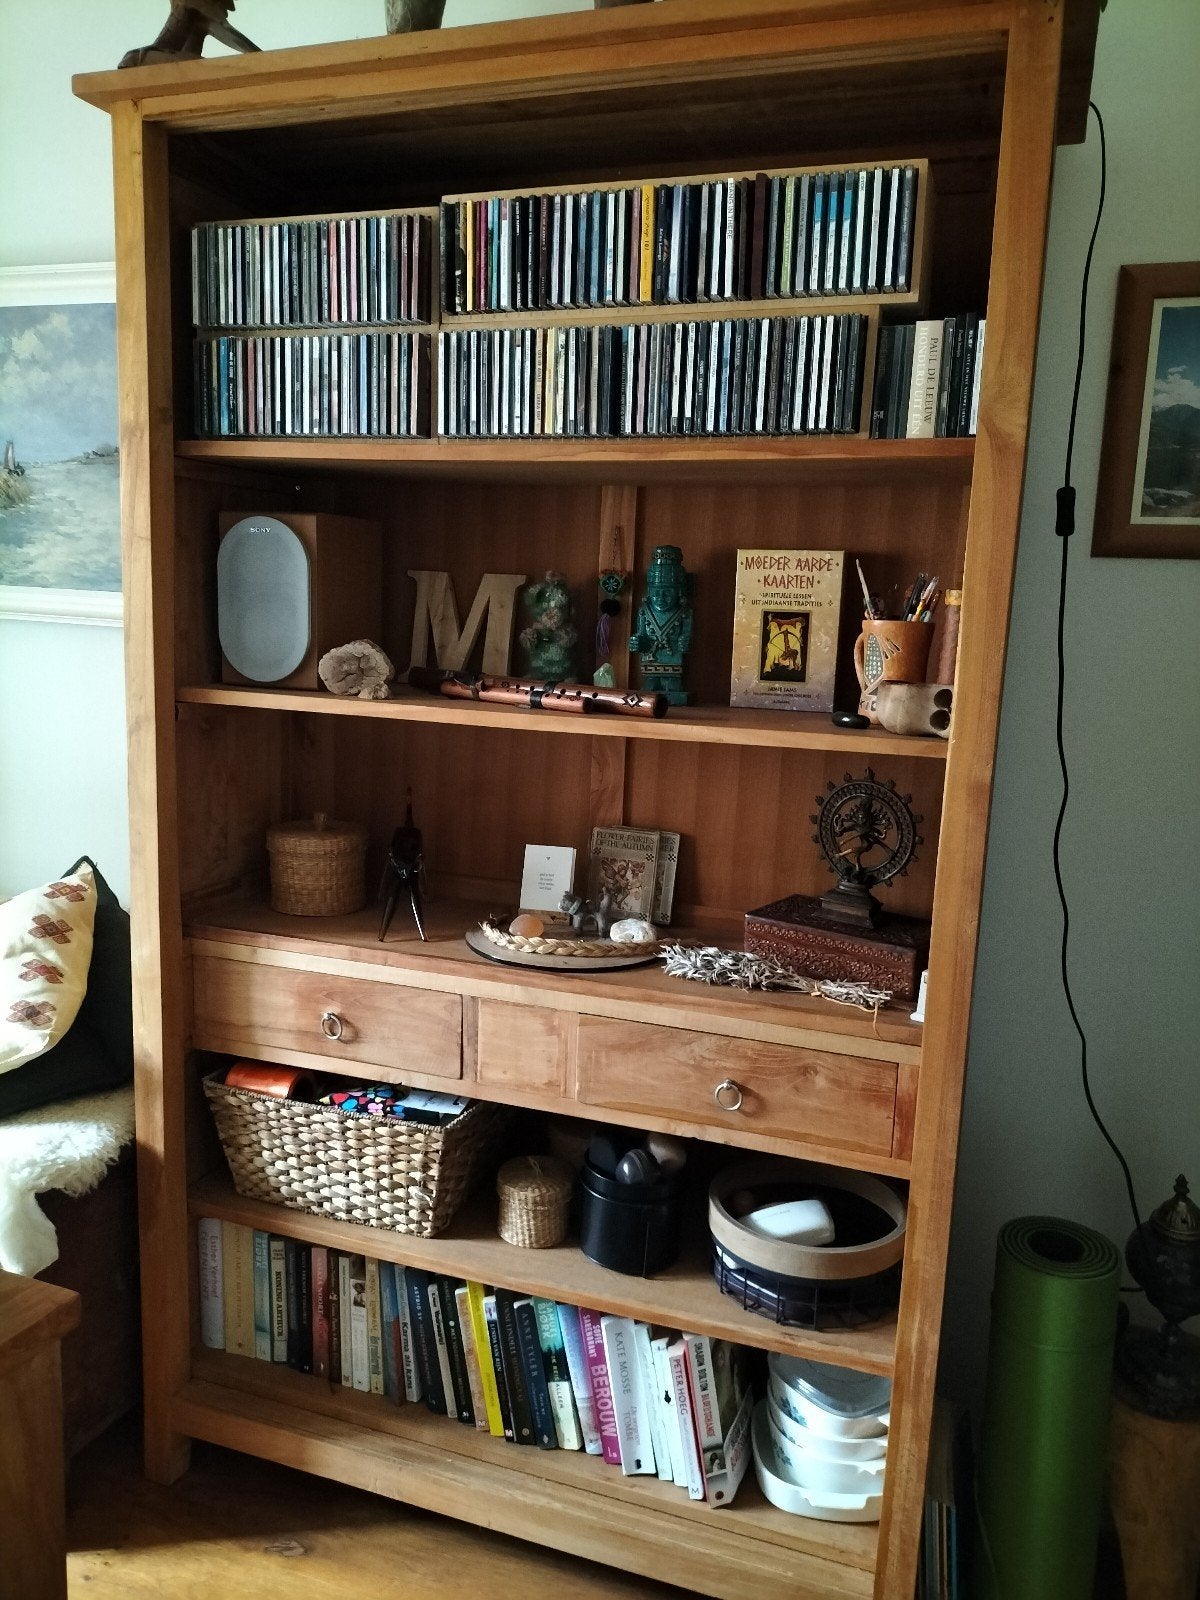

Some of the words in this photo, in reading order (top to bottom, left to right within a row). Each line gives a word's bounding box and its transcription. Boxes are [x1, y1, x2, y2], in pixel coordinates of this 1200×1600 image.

[915, 326, 928, 386] HONDERD
[928, 337, 938, 364] PAUL
[926, 368, 935, 383] DE
[913, 390, 922, 407] UIT
[923, 386, 934, 423] LEEUW
[910, 413, 922, 434] ÉÉN
[745, 555, 791, 571] MOEDER
[795, 557, 834, 572] AARDE
[763, 574, 815, 589] KAARTEN
[597, 831, 624, 842] FLOWER
[607, 840, 618, 848] THE
[623, 841, 654, 852] AUTUMN
[413, 1285, 421, 1310] ASTRID
[417, 1312, 422, 1320] SY
[521, 1312, 532, 1339] ANNE
[536, 1302, 550, 1338] BJØRK
[545, 1301, 557, 1337] SAMUEL
[401, 1321, 410, 1352] Karma
[489, 1323, 498, 1344] LINDA
[506, 1323, 516, 1354] LINDELL
[582, 1314, 596, 1357] SARENBRANT
[592, 1324, 602, 1344] SOFIE
[613, 1331, 626, 1357] KATE
[404, 1354, 412, 1366] als
[526, 1345, 538, 1376] TYLER
[693, 1342, 706, 1366] SHARON
[405, 1368, 414, 1389] kans
[618, 1361, 631, 1394] MOSSE
[672, 1359, 683, 1386] PETER
[697, 1368, 709, 1391] BOLTON
[555, 1382, 564, 1408] ALLEEN
[590, 1363, 616, 1438] BEROUW
[622, 1411, 633, 1441] TOMBE
